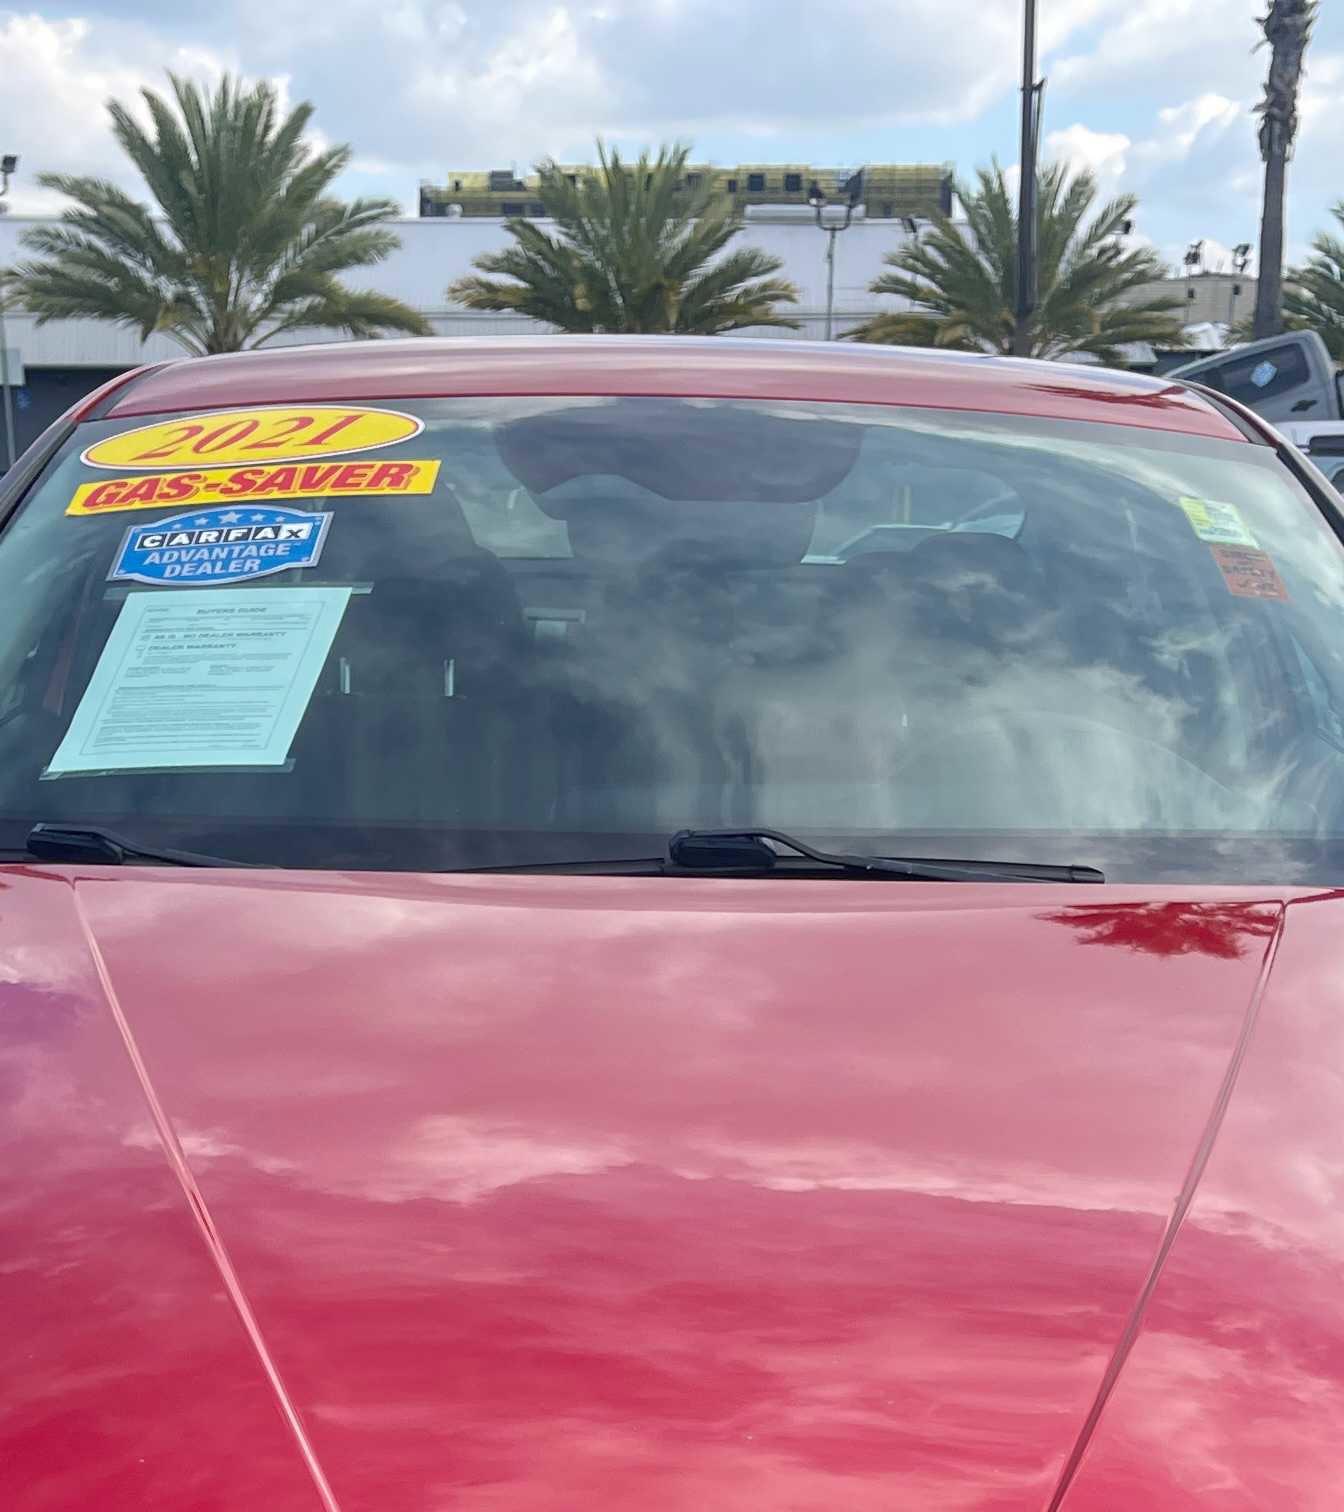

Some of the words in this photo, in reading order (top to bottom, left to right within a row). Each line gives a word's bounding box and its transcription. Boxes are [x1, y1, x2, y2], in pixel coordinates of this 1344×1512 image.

[129, 414, 367, 462] 2021
[82, 463, 416, 509] GAS-SAVER
[138, 525, 310, 550] CARFAX
[143, 543, 291, 567] ADVANTAGE
[163, 559, 262, 580] DEALER
